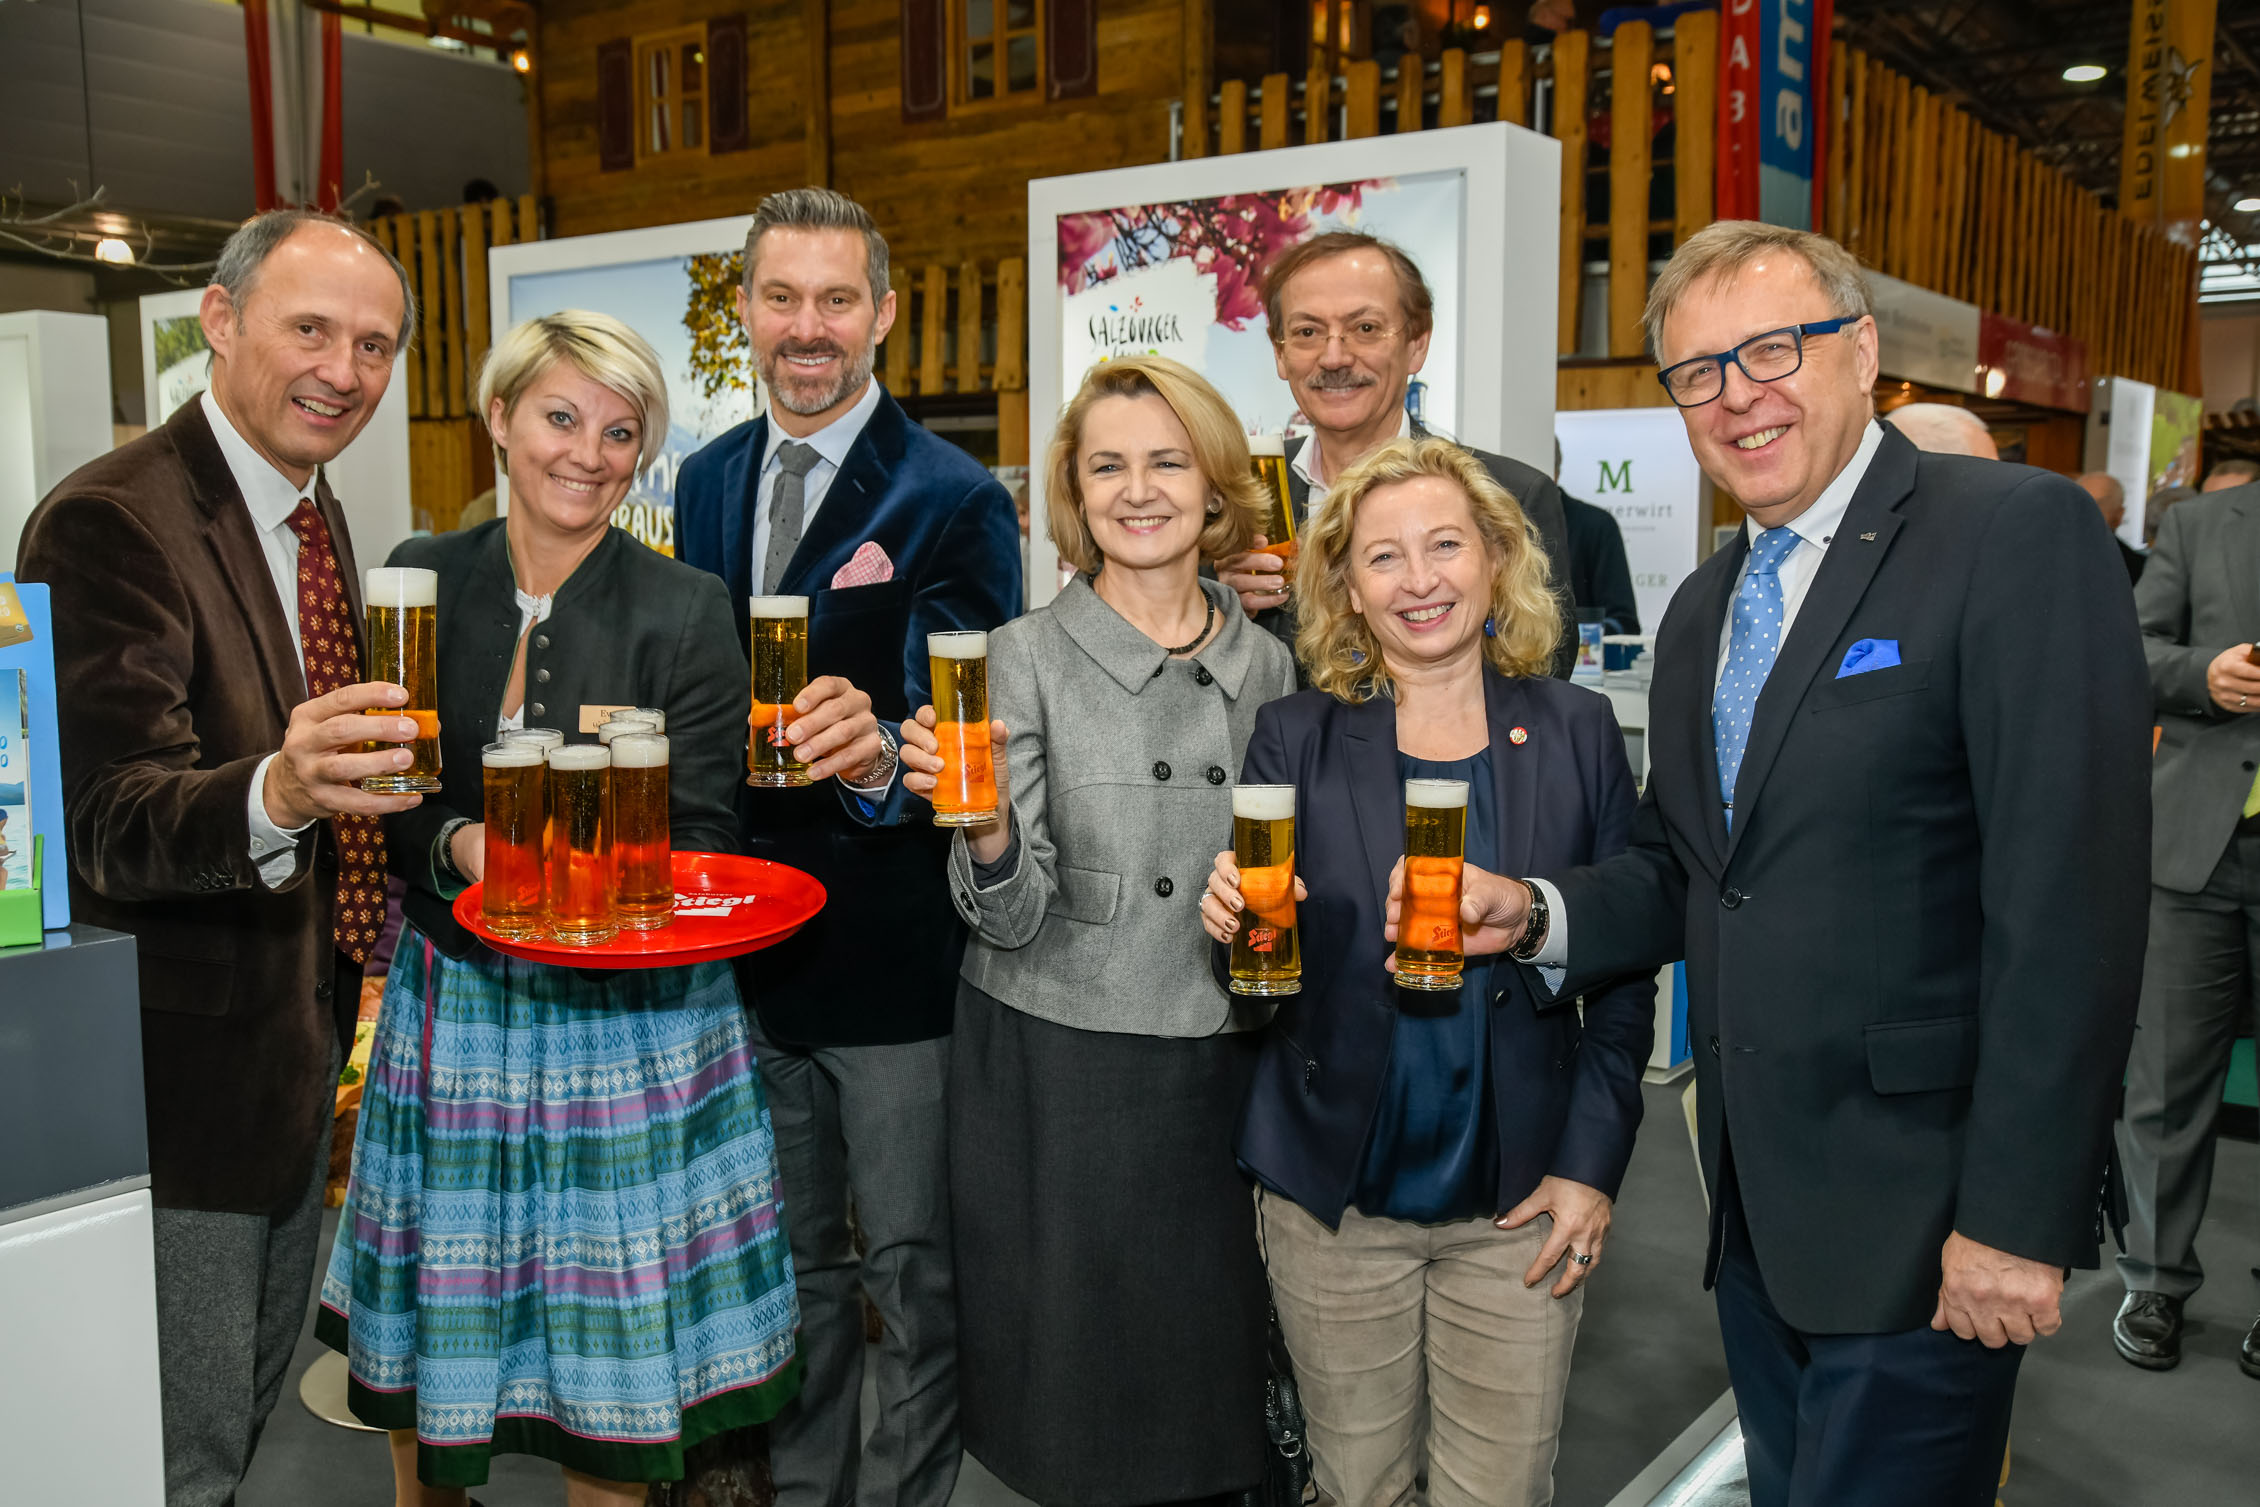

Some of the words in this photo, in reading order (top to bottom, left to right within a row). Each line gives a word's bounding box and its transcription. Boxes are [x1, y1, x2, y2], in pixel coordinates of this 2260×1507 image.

[1596, 460, 1634, 493] M
[1608, 502, 1673, 518] erwirt
[1248, 928, 1277, 948] Stiegl
